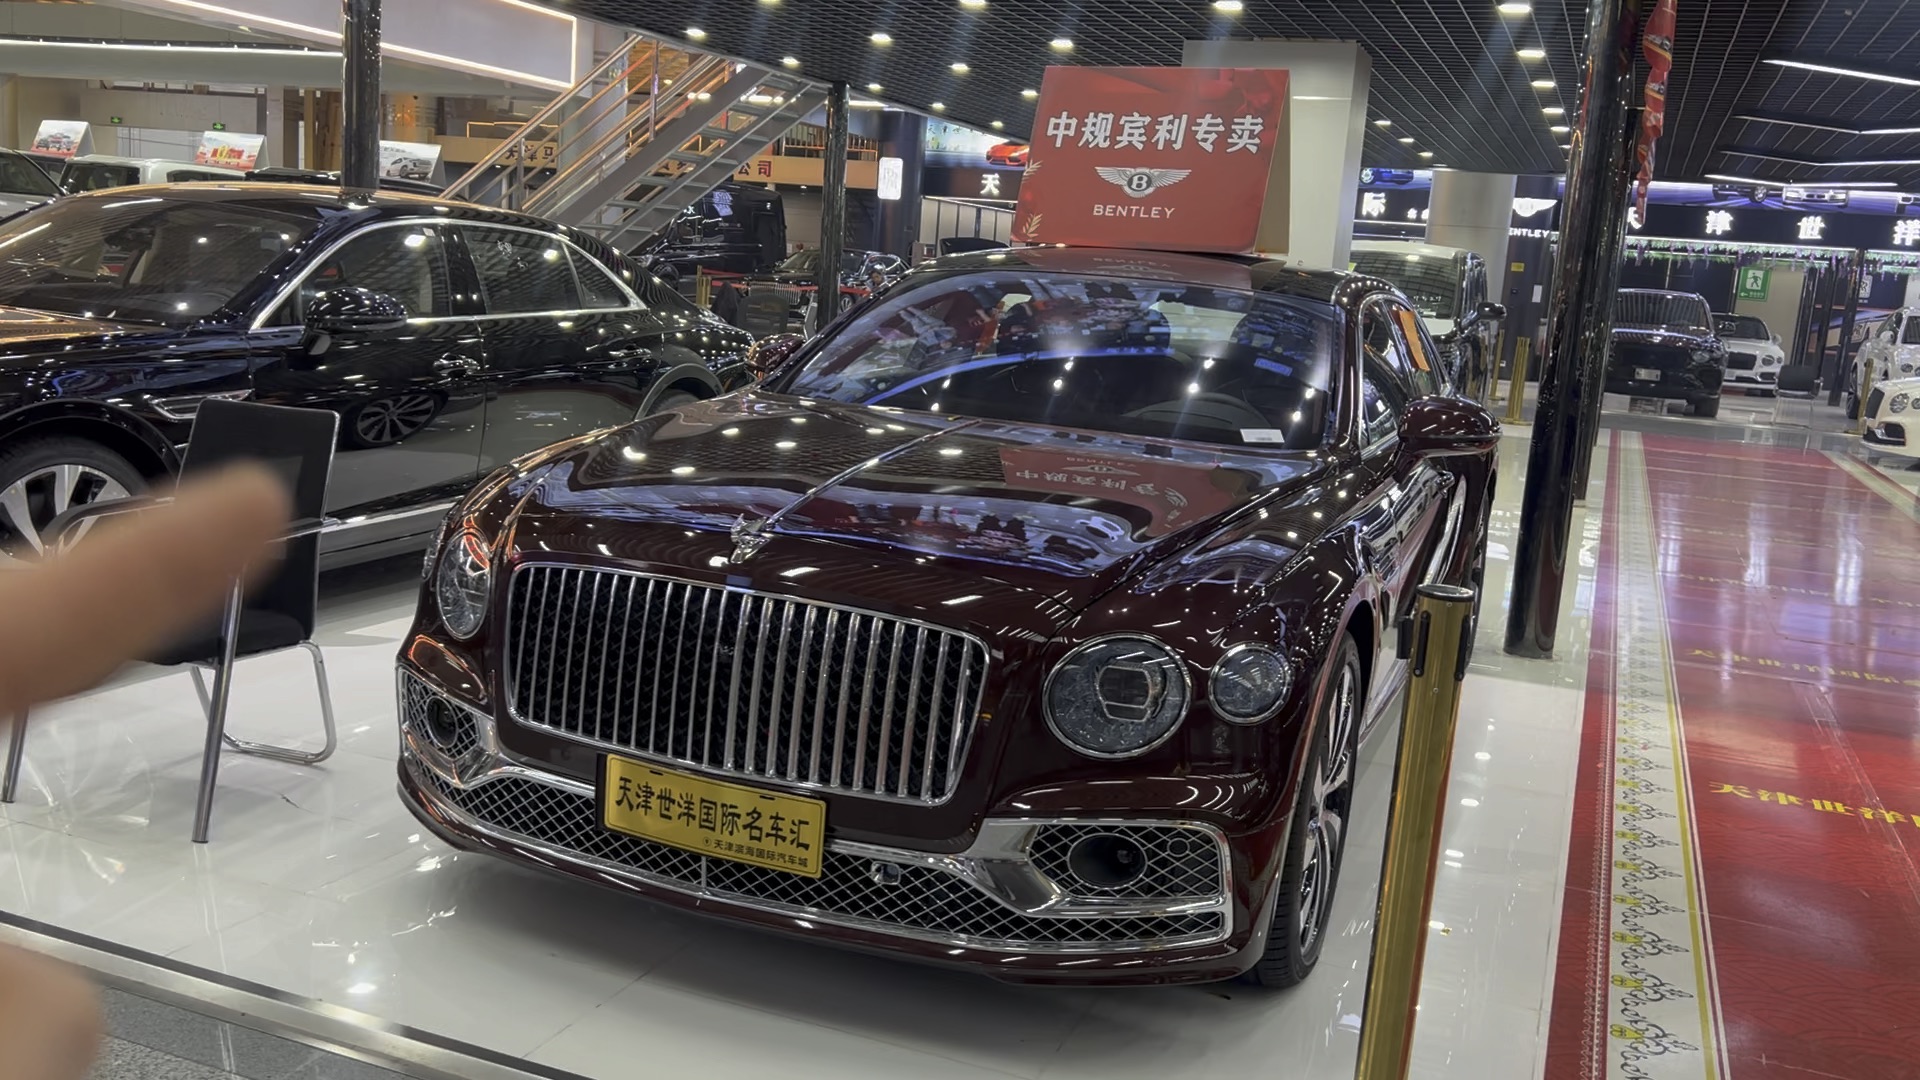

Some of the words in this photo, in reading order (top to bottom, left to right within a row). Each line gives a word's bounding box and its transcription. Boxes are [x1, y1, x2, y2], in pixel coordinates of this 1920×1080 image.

[1045, 111, 1265, 154] 中规宾利专卖
[980, 172, 1000, 196] 天
[1093, 203, 1175, 219] BENTLEY
[615, 776, 810, 851] 天津世洋国际名车汇
[1708, 781, 1920, 829] 天津世洋
[714, 840, 809, 869] 天津滨海国际汽车城
